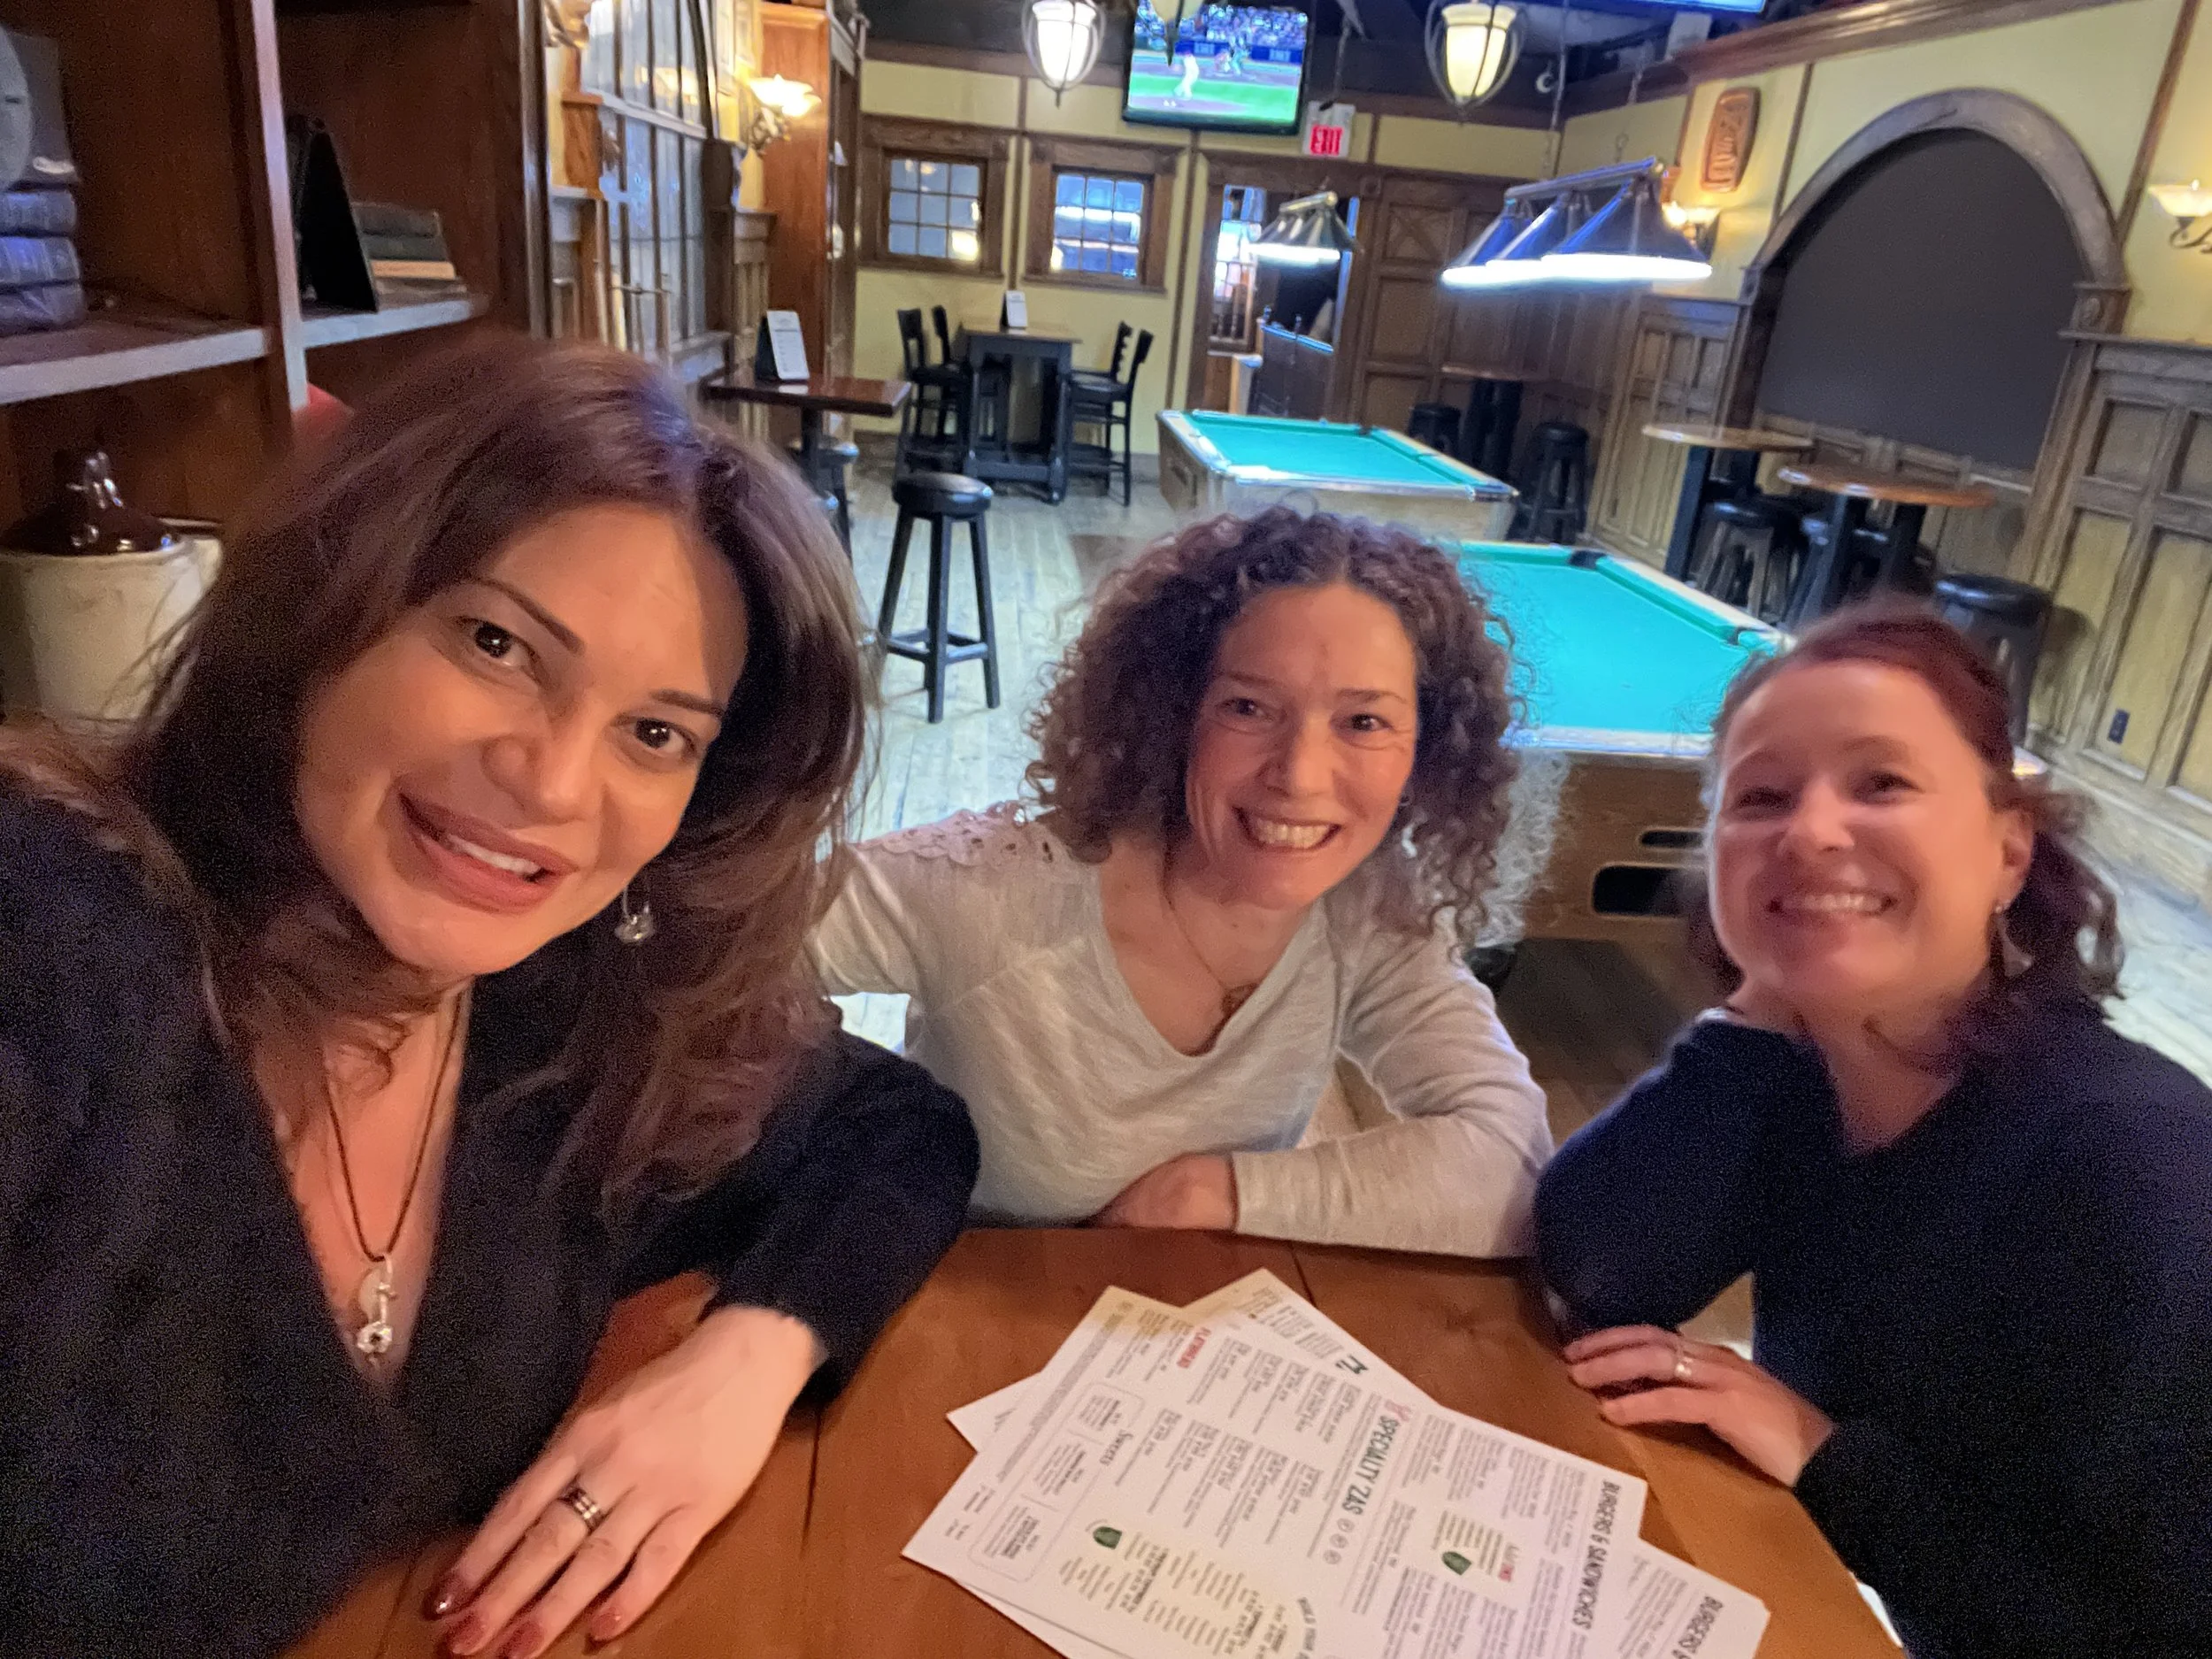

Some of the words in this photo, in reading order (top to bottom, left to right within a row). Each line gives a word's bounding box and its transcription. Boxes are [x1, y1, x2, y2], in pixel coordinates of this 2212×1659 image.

[1310, 124, 1344, 156] EXIT
[1099, 1429, 1134, 1466] Sweets
[1355, 1415, 1402, 1483] SPECIALTY
[1593, 1479, 1621, 1535] BURGERS
[1571, 1545, 1608, 1630] SANDWICHES
[1678, 1595, 1724, 1654] BURGERS
